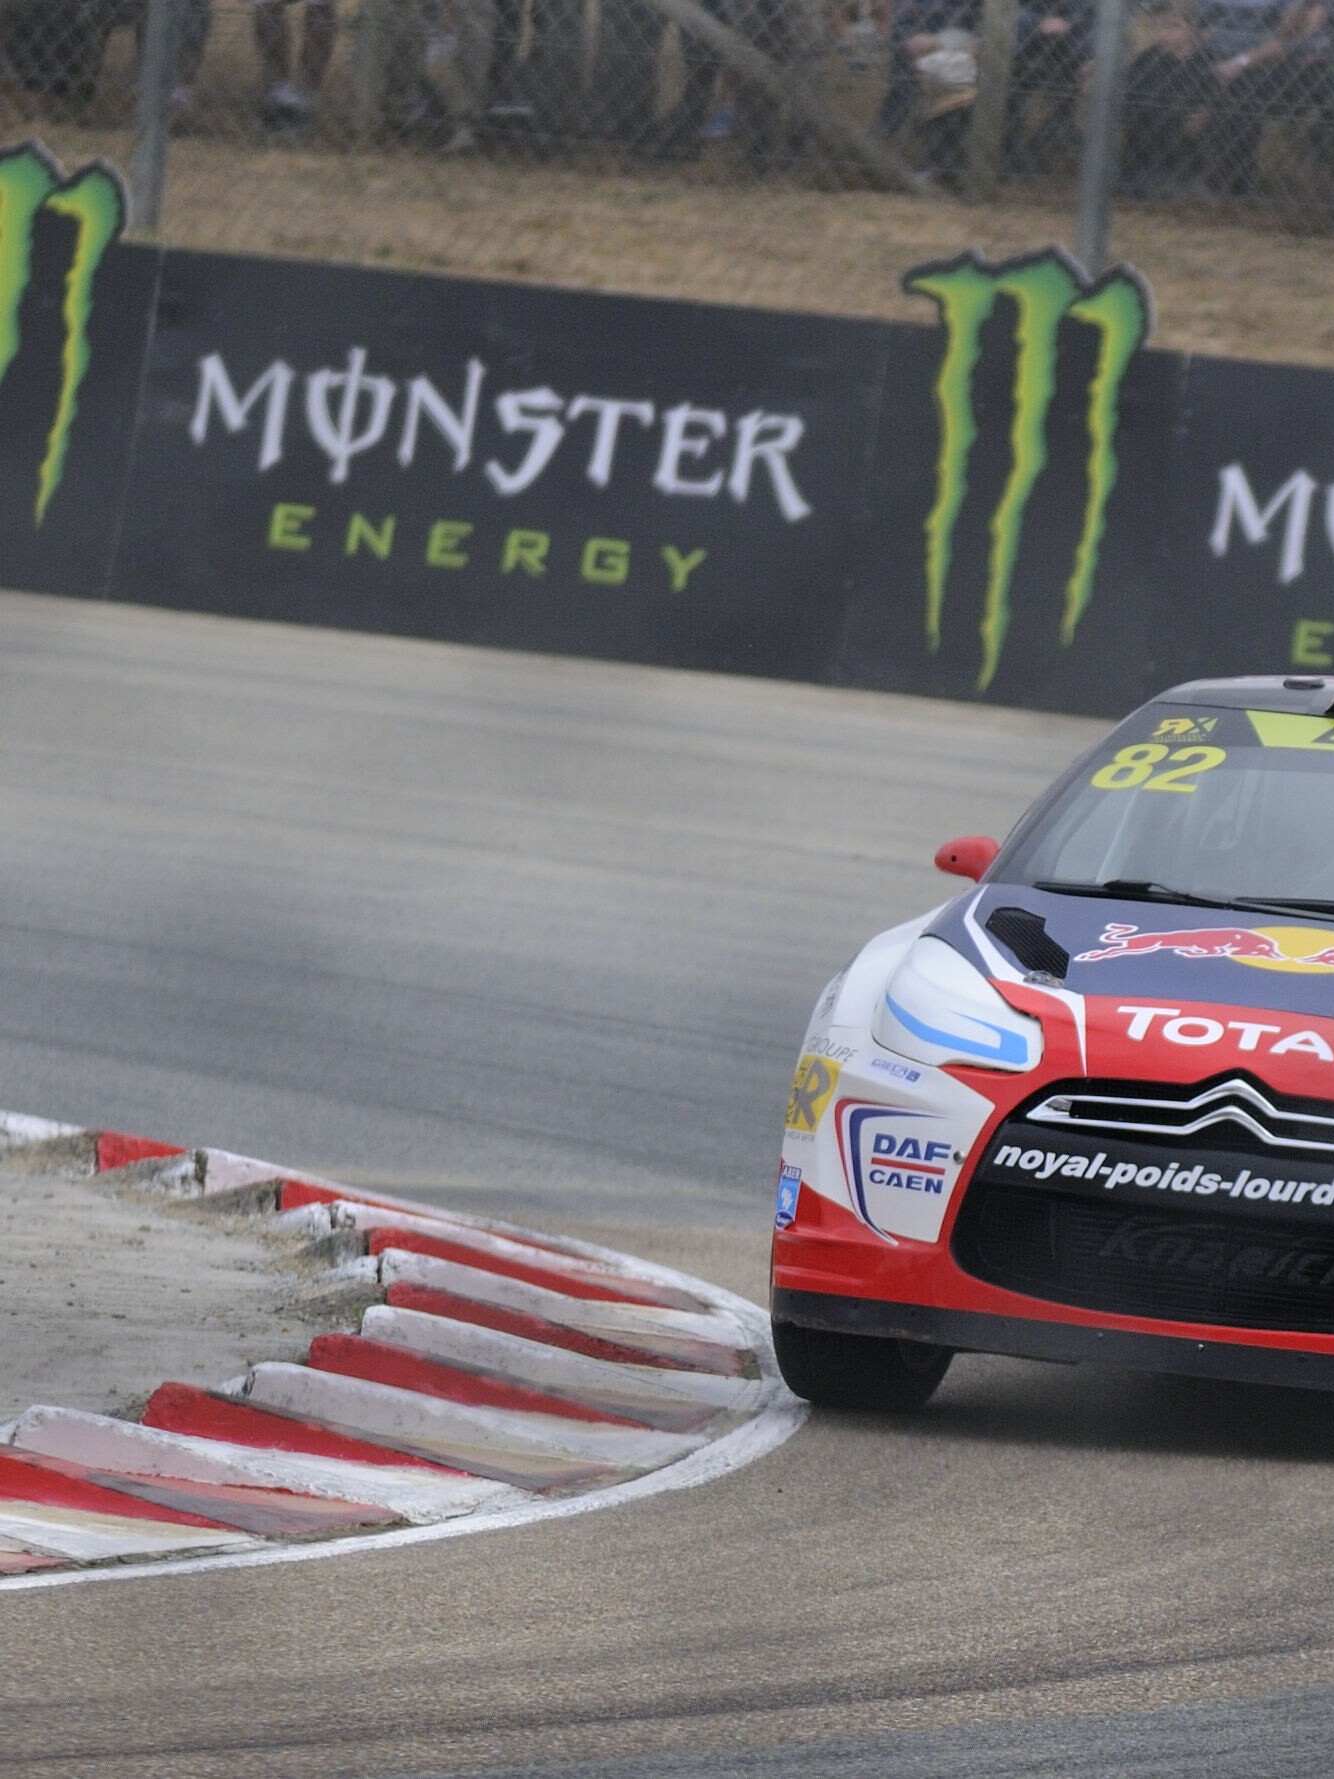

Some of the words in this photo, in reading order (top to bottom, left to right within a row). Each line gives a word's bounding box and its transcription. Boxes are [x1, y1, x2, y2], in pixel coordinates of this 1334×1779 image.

[191, 346, 812, 522] MONSTER
[267, 501, 708, 591] ENERGY
[1090, 743, 1228, 793] 82
[872, 1133, 952, 1162] DAF
[868, 1169, 944, 1195] CAEN
